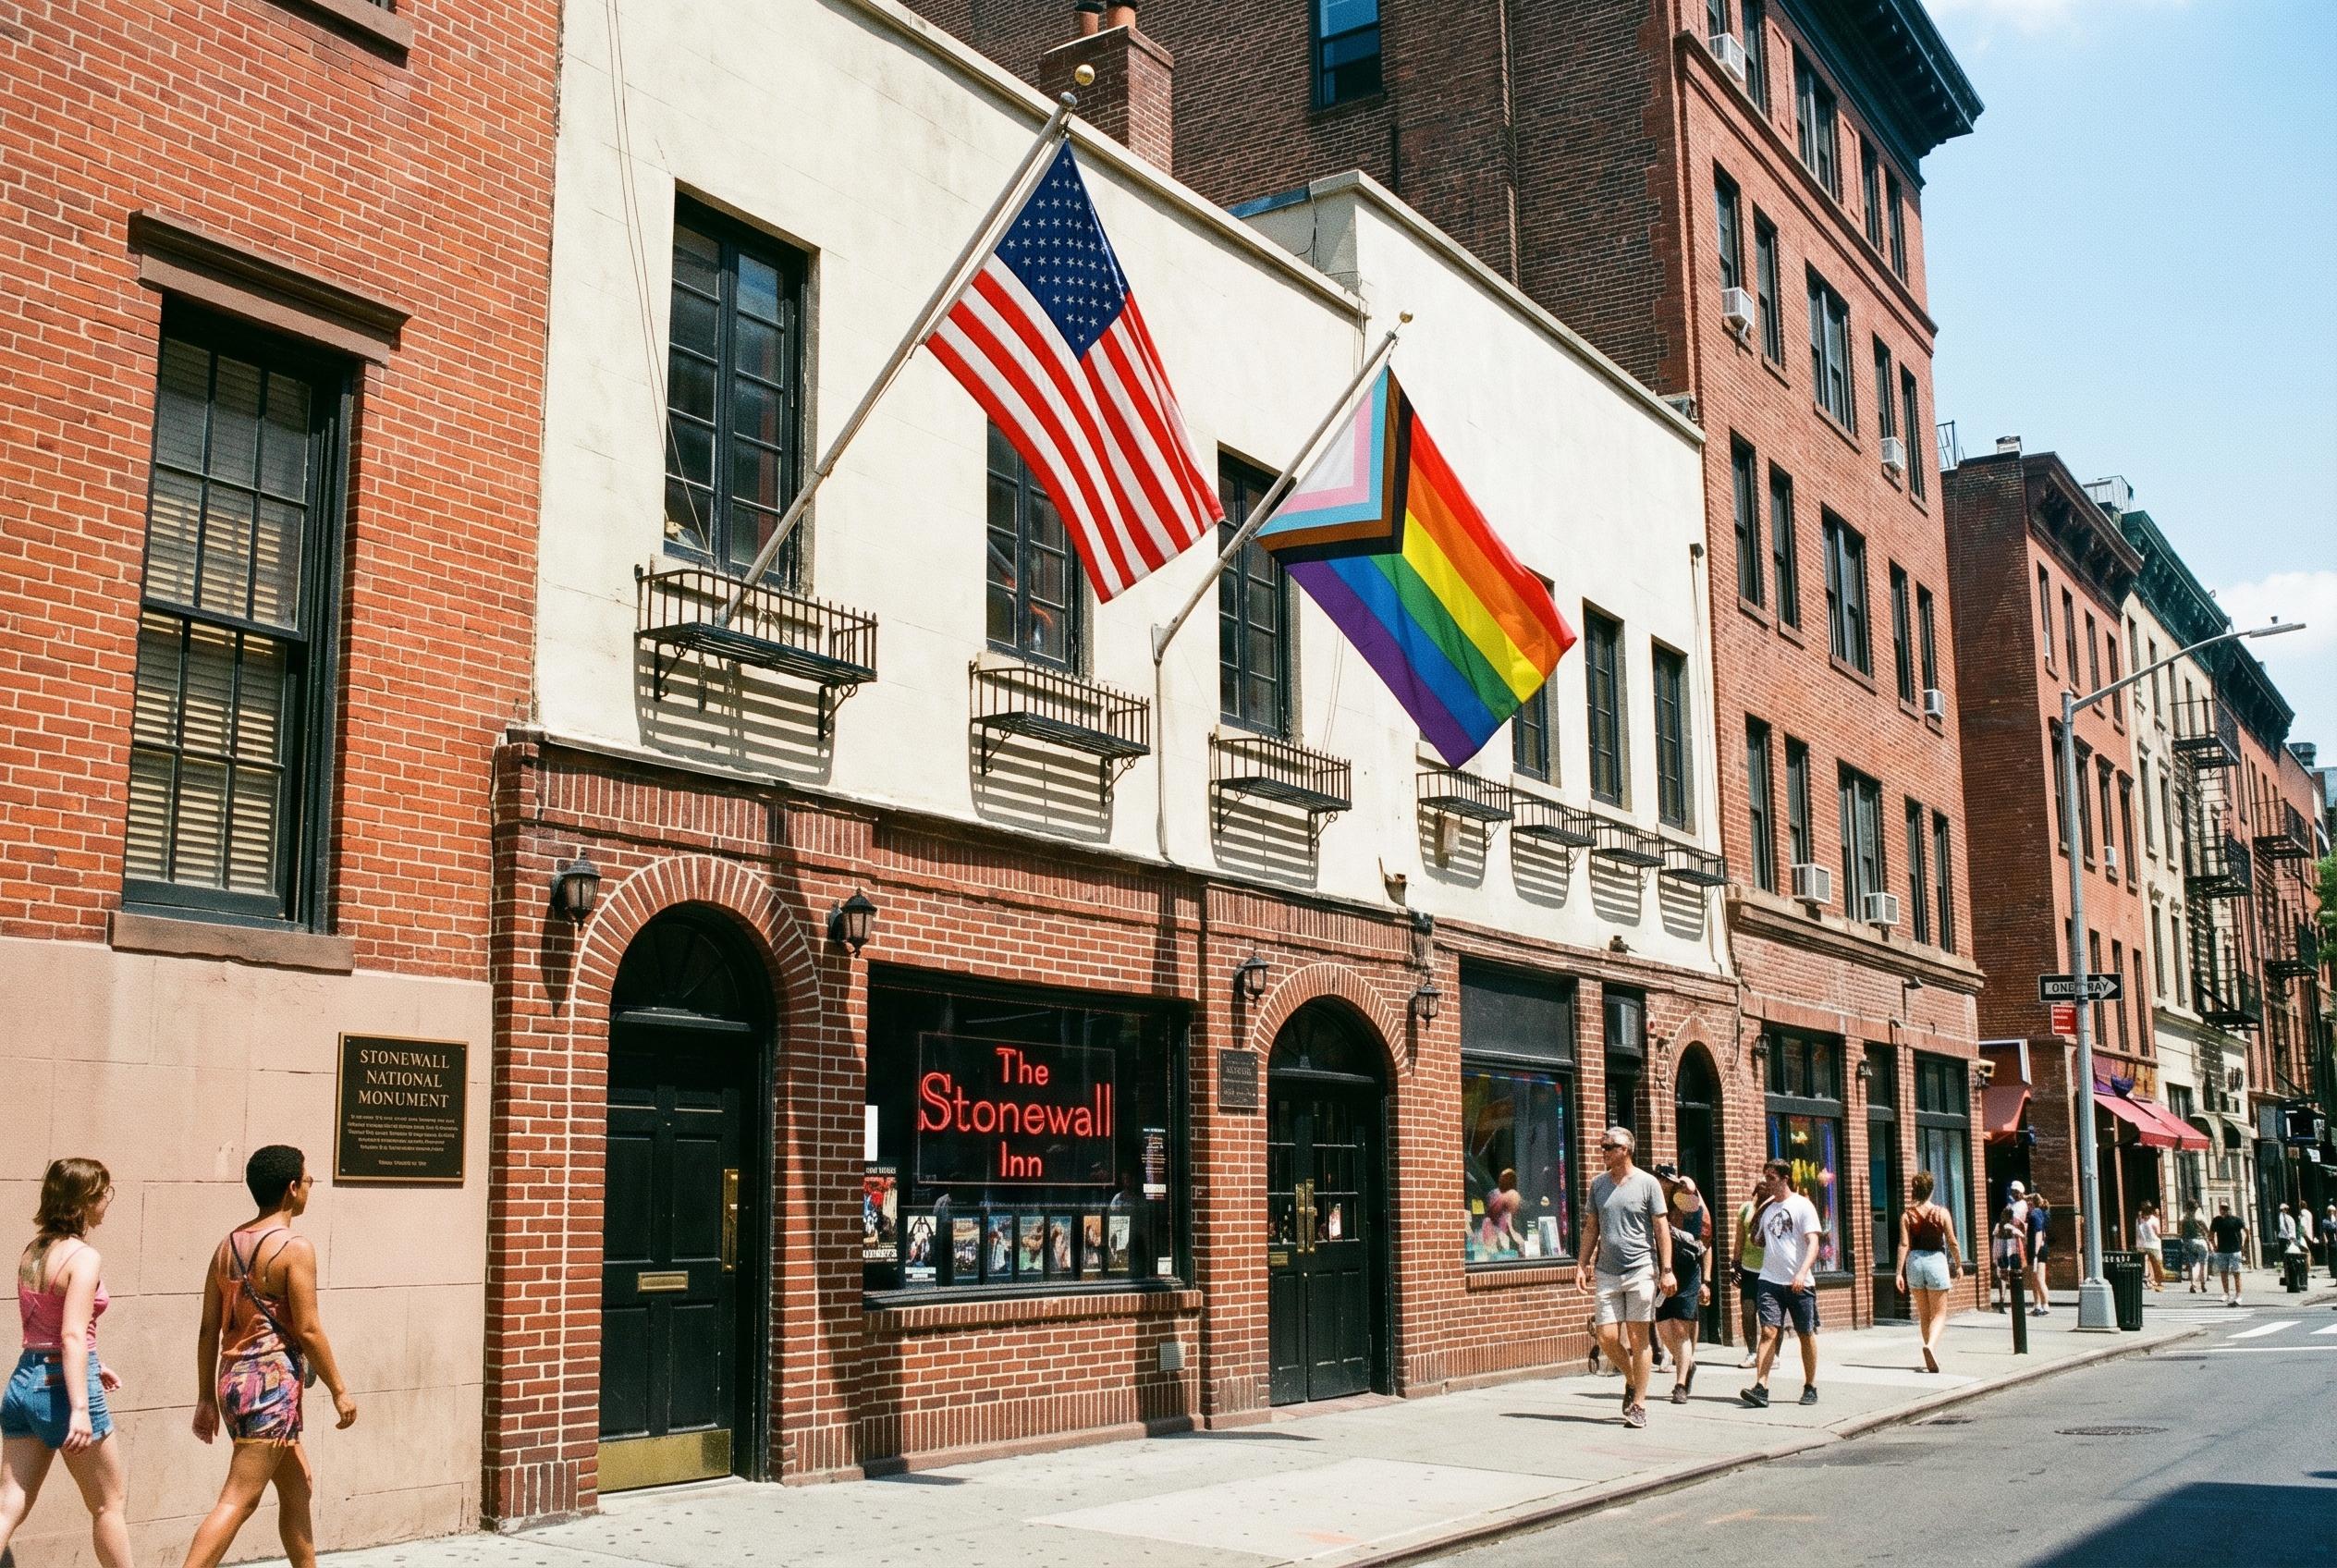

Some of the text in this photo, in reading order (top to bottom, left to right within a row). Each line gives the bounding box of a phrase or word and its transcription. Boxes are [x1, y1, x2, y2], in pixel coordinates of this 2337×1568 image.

[2052, 983, 2074, 993] ONE
[360, 1049, 450, 1068] STONEWALL
[997, 1047, 1049, 1085] The
[366, 1070, 443, 1087] NATIONAL
[359, 1090, 449, 1108] MONUMENT
[918, 1072, 1111, 1137] Stonewall
[1000, 1141, 1043, 1178] Inn
